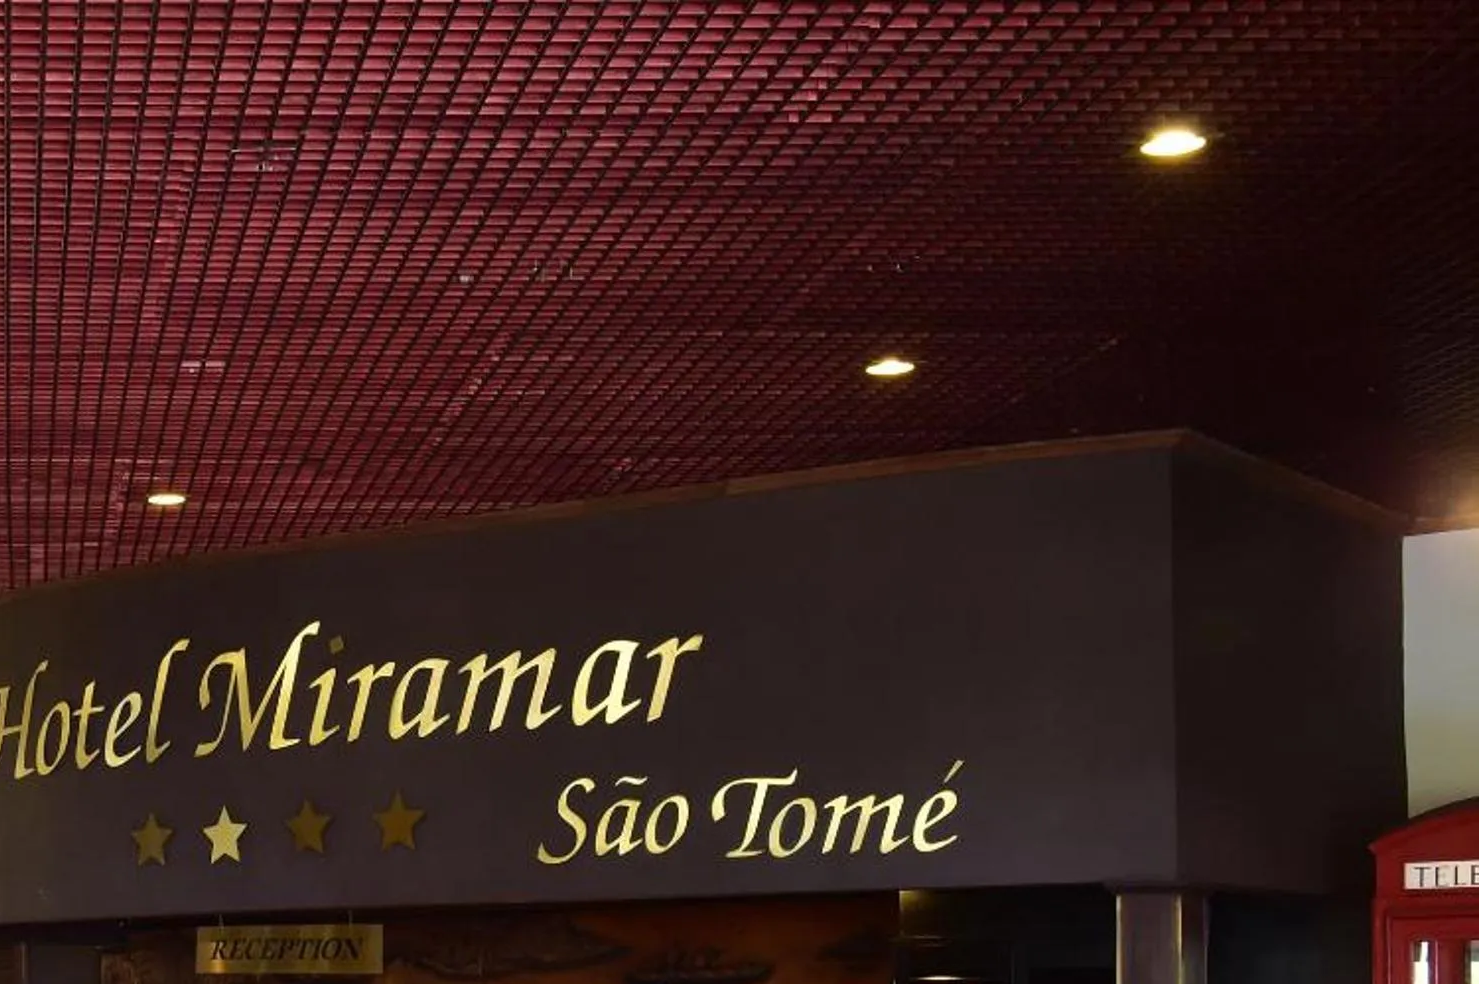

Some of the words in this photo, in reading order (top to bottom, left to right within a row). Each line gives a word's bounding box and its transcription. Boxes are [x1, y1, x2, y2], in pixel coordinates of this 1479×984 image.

[195, 620, 704, 758] Miramar
[537, 776, 691, 865] São
[711, 759, 965, 859] Tomé
[211, 937, 364, 961] RECEPTION
